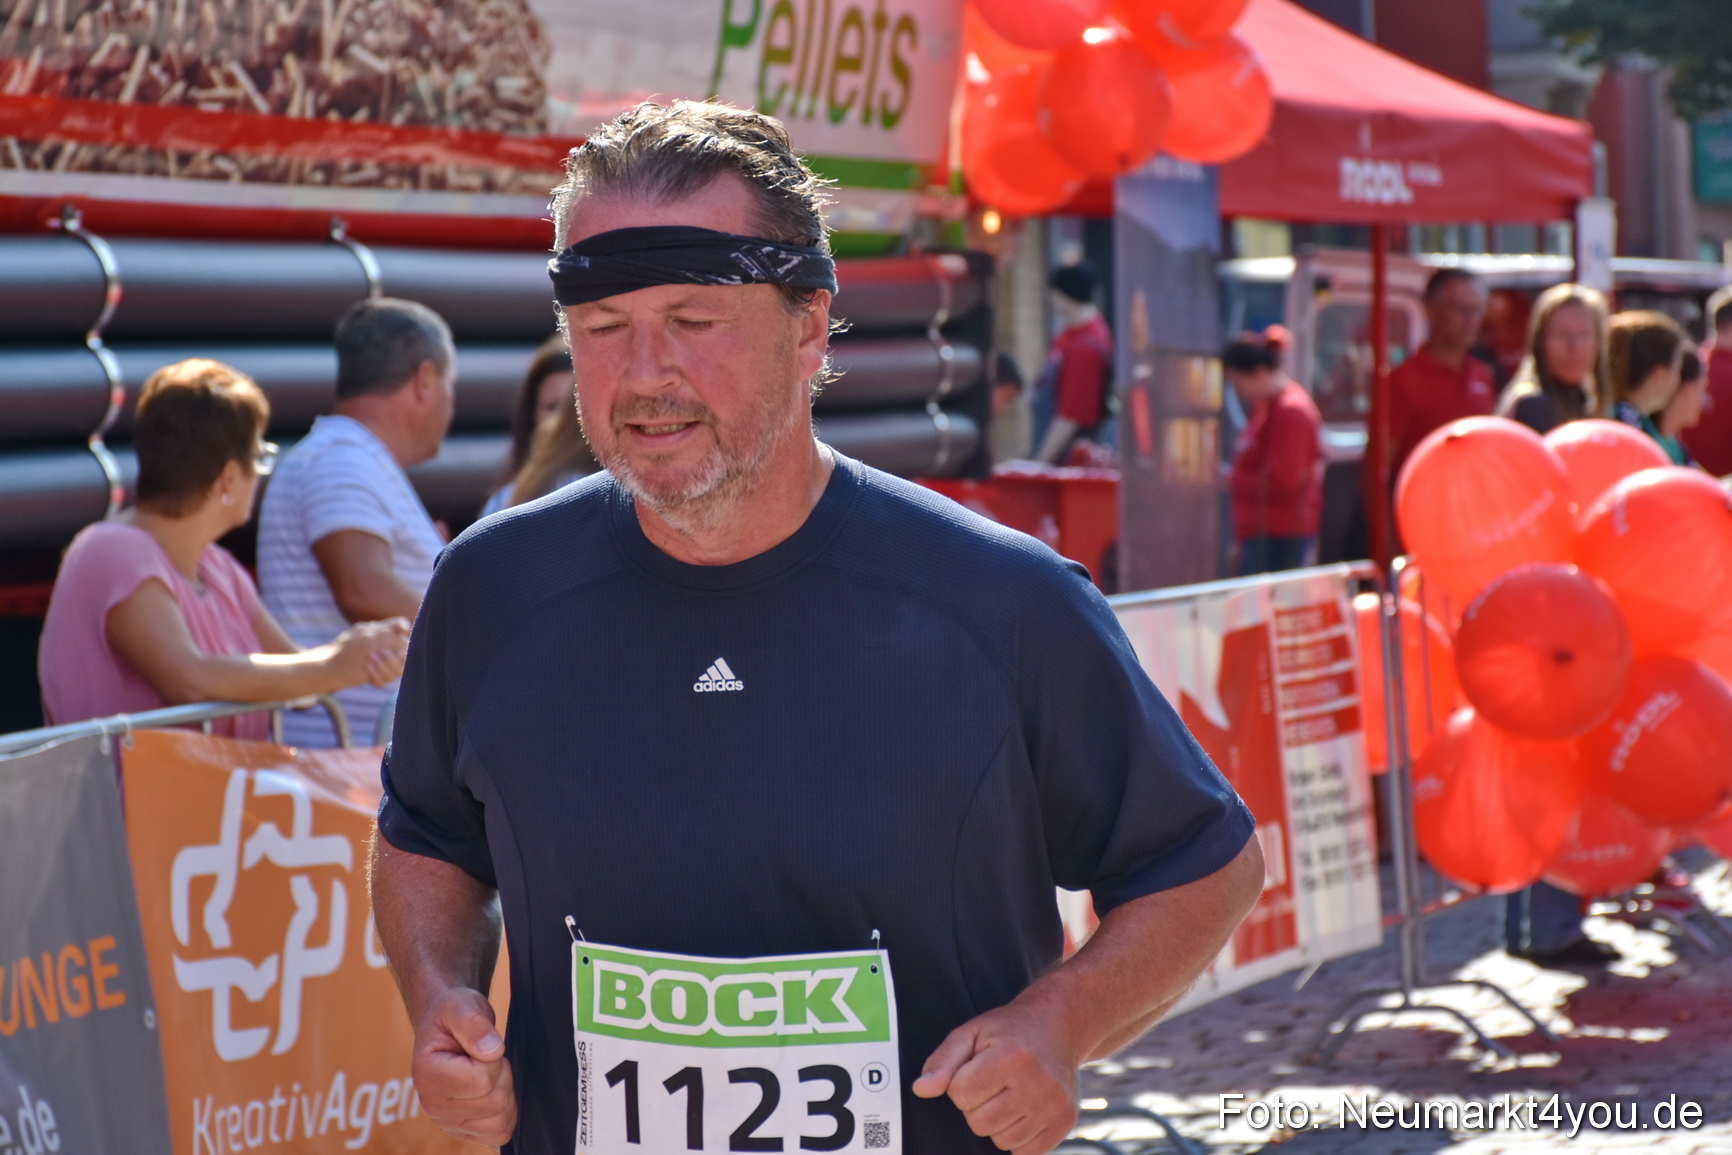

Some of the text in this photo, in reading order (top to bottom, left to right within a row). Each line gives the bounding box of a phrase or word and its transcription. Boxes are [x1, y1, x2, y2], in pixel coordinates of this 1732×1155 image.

[707, 0, 918, 130] Pellets
[693, 679, 744, 692] adidas
[0, 935, 127, 1037] UNGE
[597, 966, 858, 1032] BOCK
[604, 1059, 856, 1153] 1123
[868, 1069, 882, 1085] D
